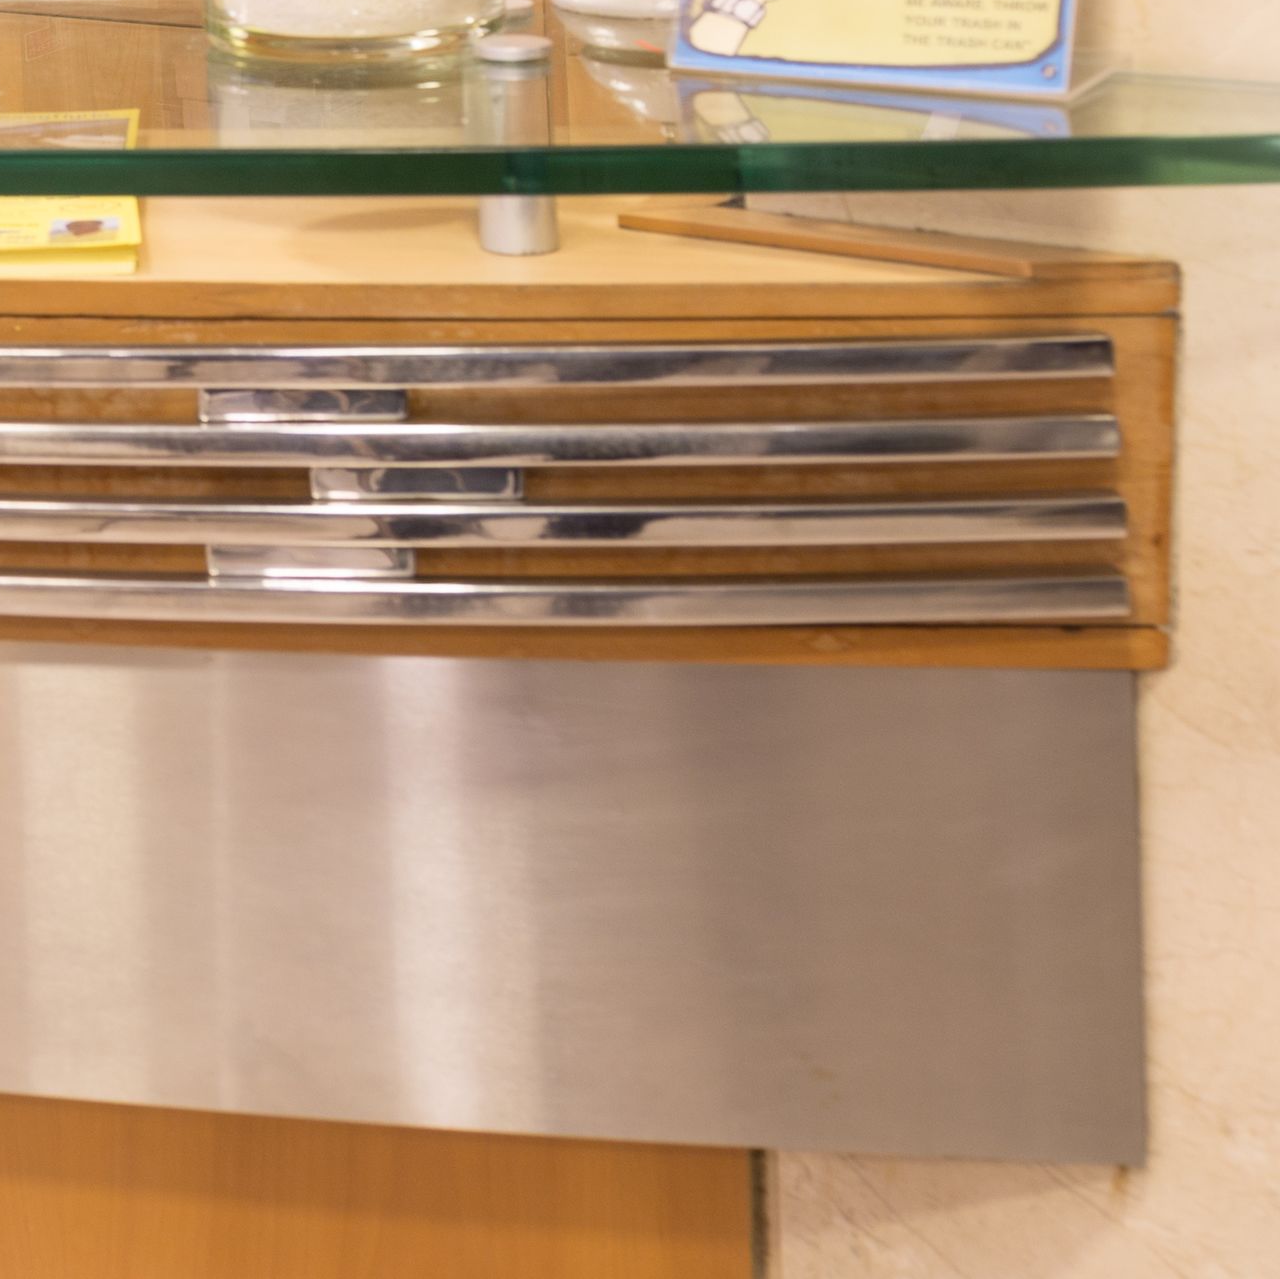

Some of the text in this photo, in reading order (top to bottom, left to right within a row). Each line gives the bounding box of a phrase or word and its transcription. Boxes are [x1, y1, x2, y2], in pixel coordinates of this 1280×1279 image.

[904, 14, 946, 27] YOUR
[952, 17, 1001, 30] TRASH
[902, 33, 930, 46] THE
[936, 35, 986, 48] TRASH
